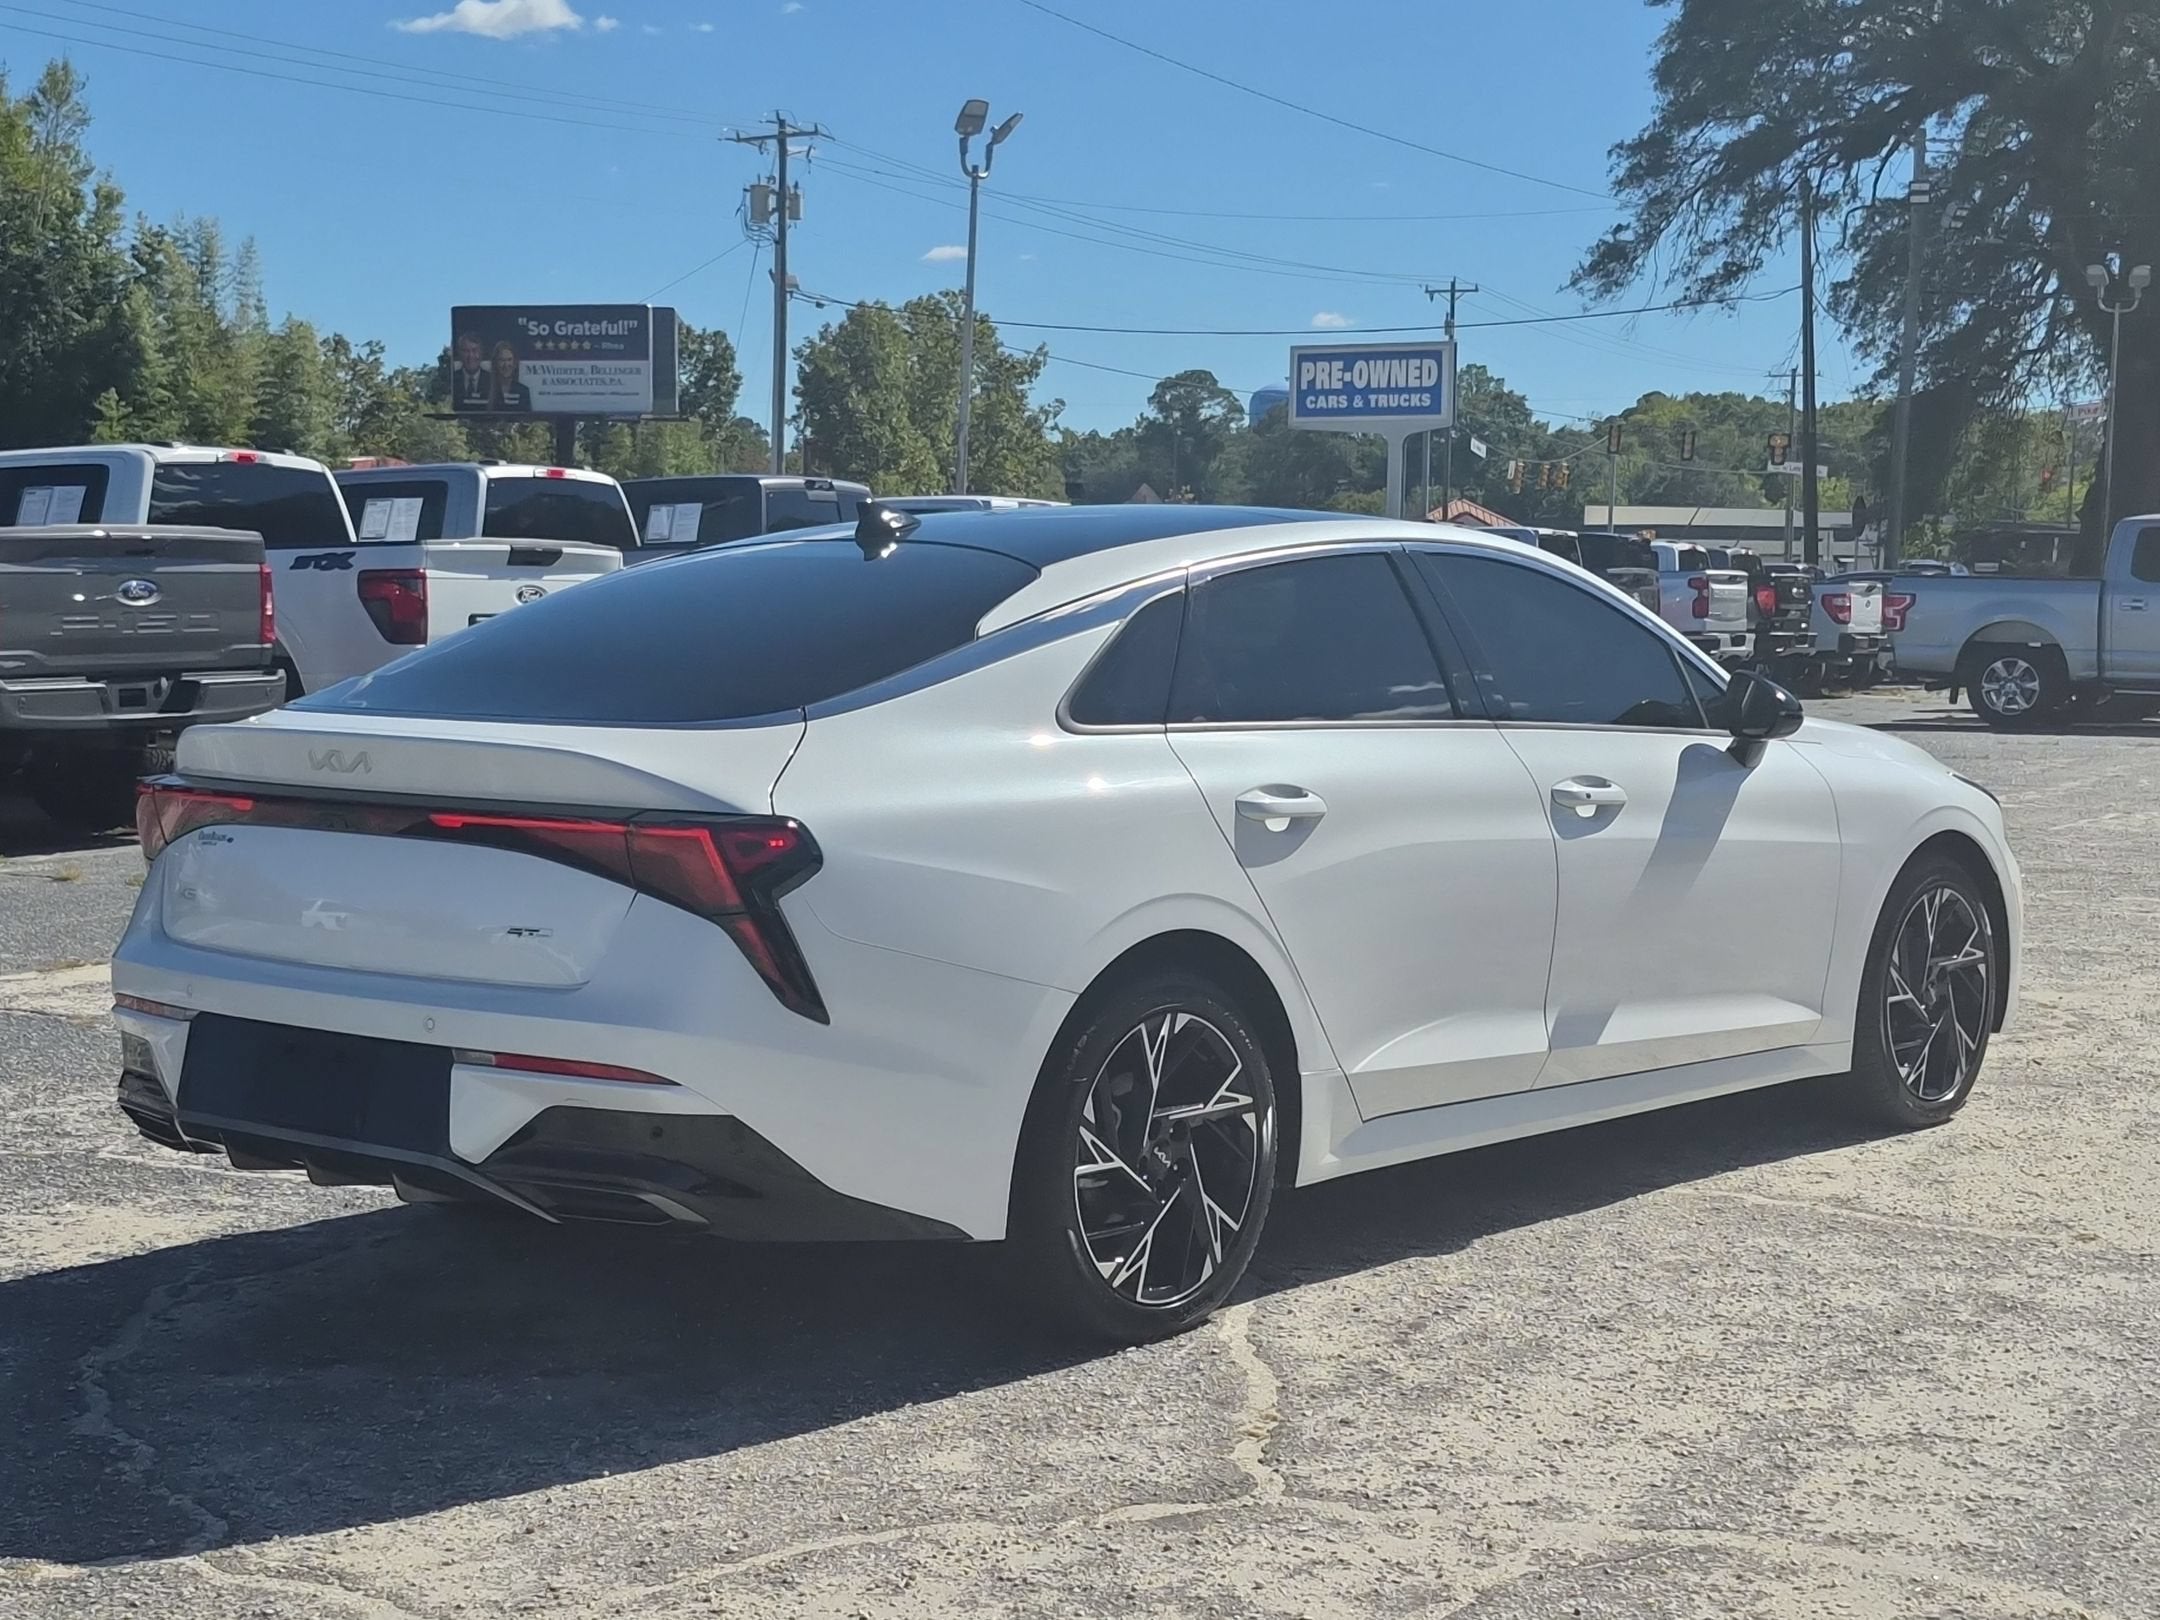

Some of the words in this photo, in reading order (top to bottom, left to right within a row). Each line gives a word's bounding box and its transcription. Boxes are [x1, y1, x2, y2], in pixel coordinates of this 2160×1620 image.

[554, 320, 638, 335] Grateful!"
[1300, 358, 1438, 391] PRE-OWNED
[1305, 395, 1348, 409] CARS
[1352, 394, 1364, 408] &
[1368, 393, 1431, 408] TRUCKS
